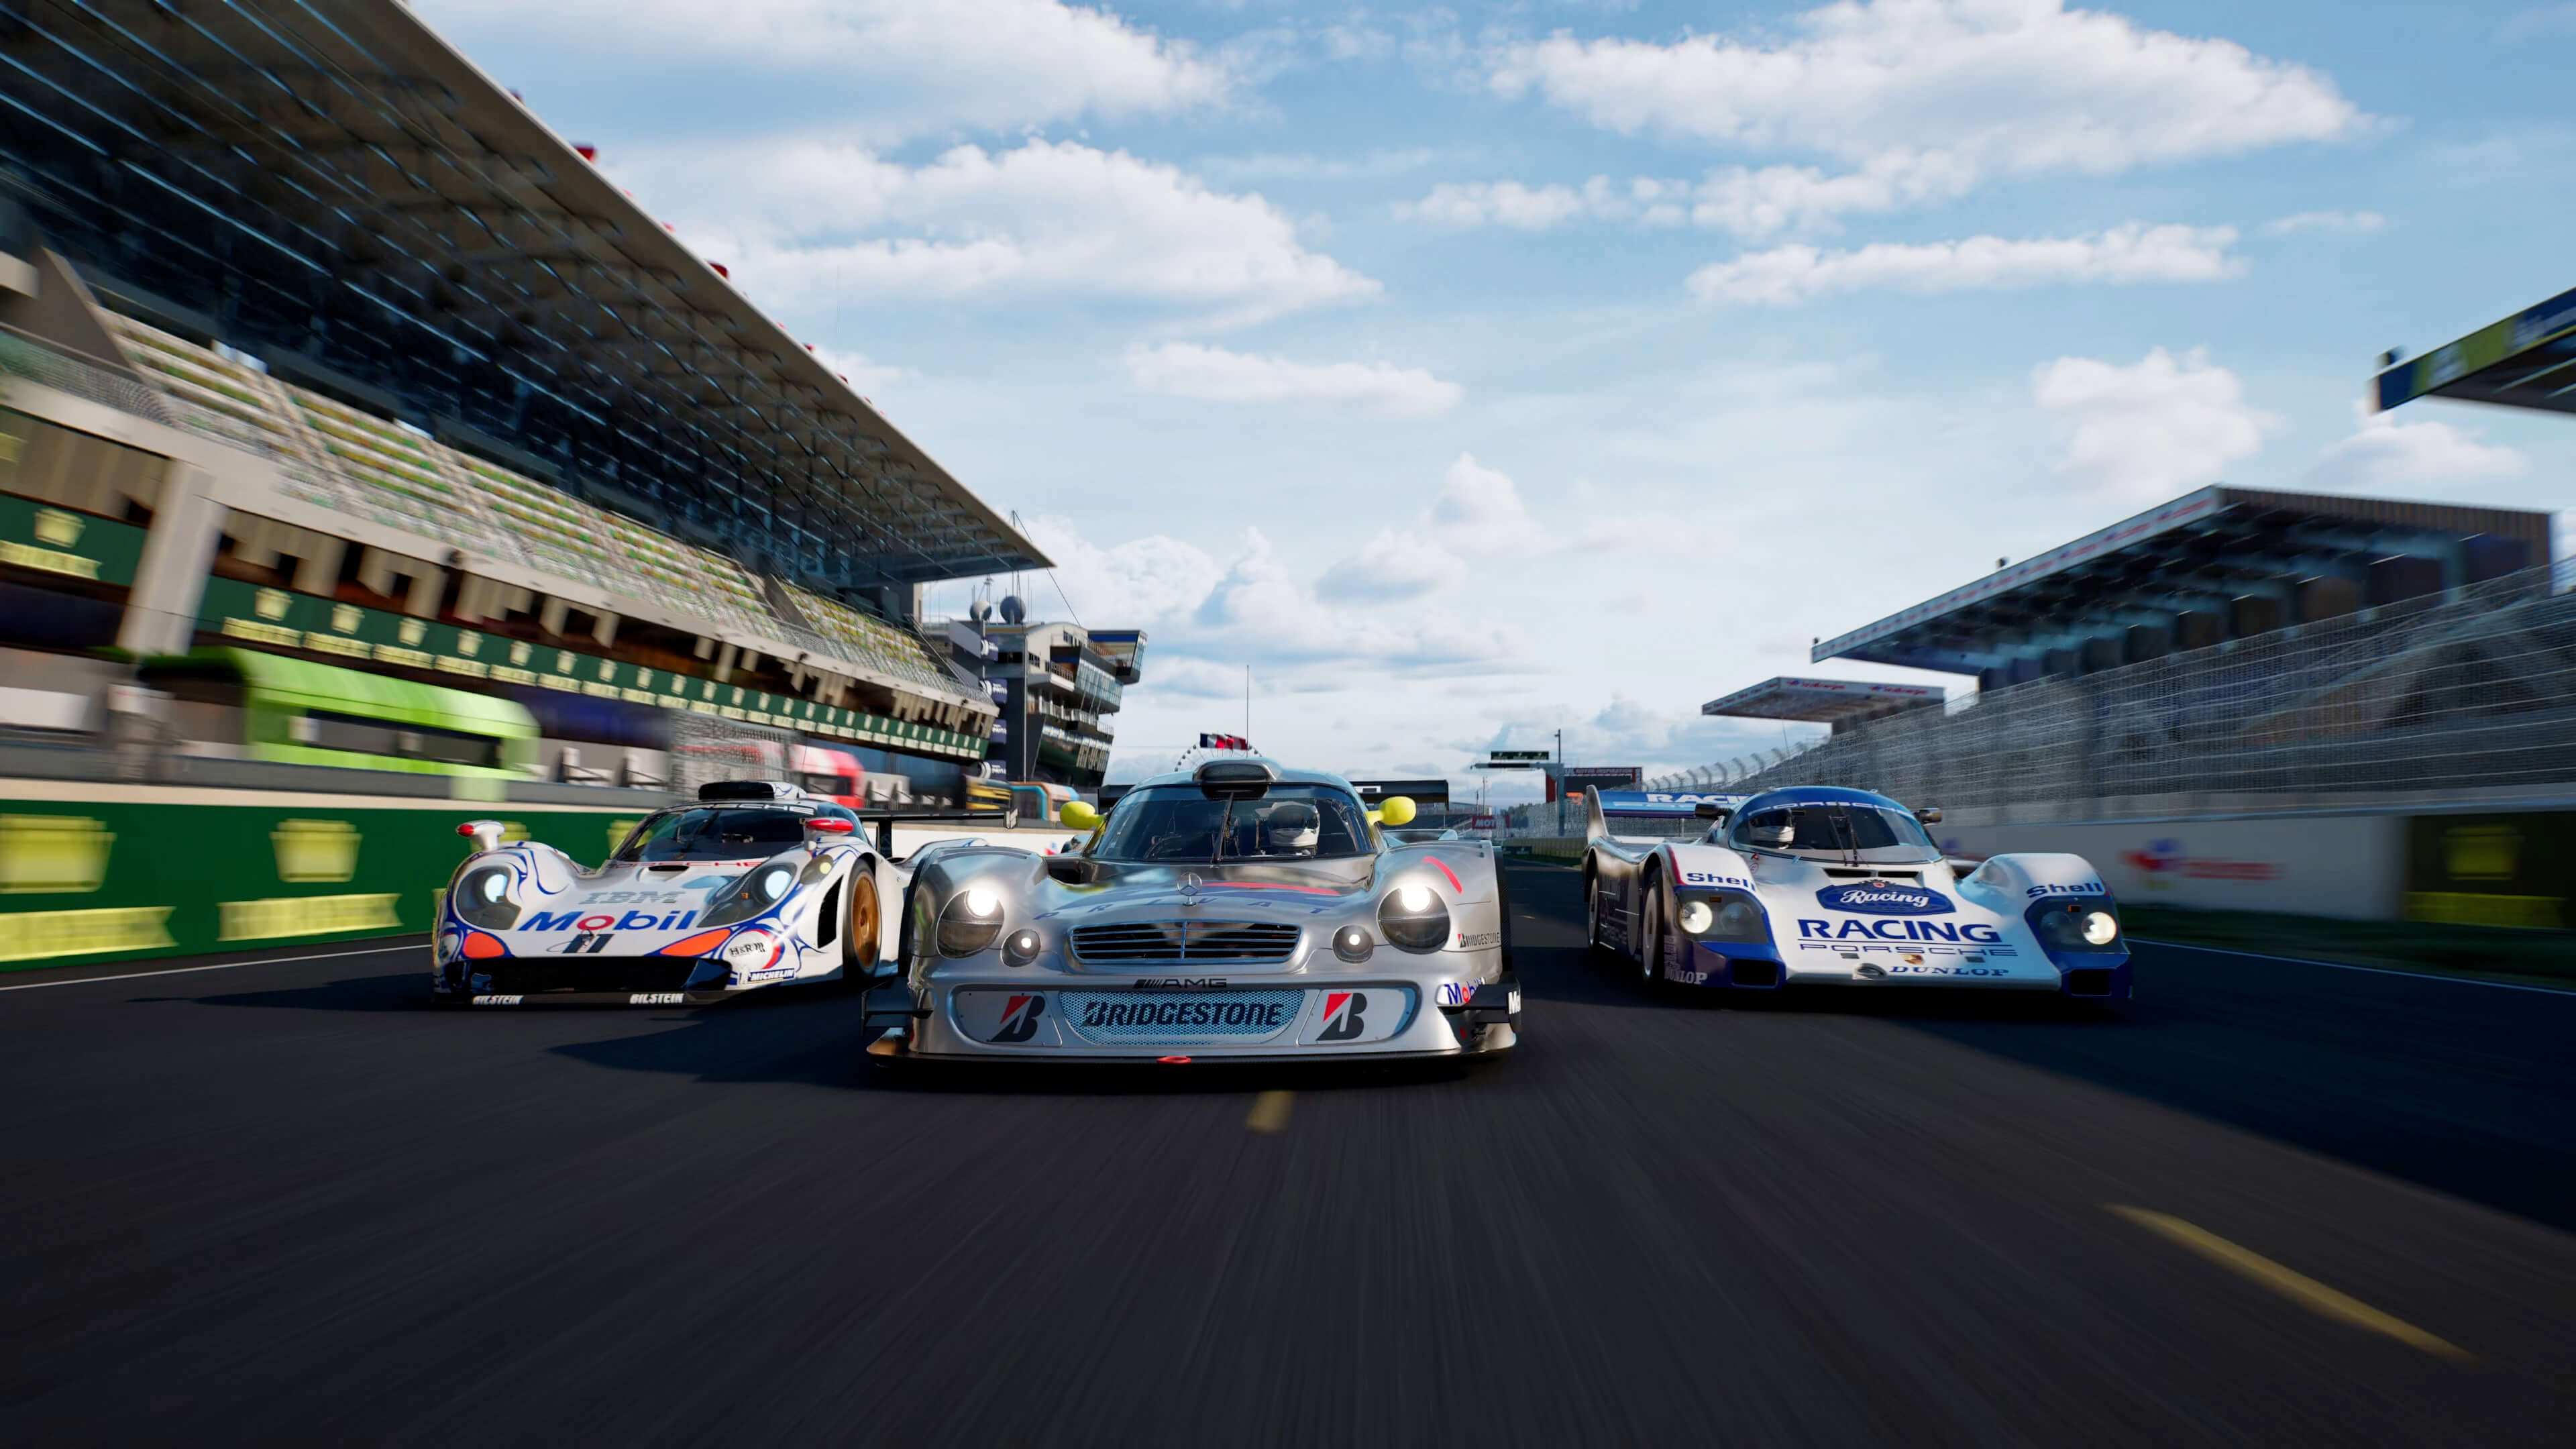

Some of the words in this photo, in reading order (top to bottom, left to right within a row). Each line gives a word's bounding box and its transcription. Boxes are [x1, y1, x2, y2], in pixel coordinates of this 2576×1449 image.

[1687, 873, 1756, 892] Shell
[579, 891, 686, 904] IBM
[2026, 883, 2104, 898] Shell
[1840, 890, 1929, 907] Racing
[517, 910, 699, 931] Mobil
[1797, 919, 2002, 943] RACING
[1458, 932, 1500, 948] BRIDGESTONE
[1800, 943, 2019, 957] PORSCHE
[751, 970, 794, 981] MICHELIN
[1889, 966, 2009, 977] DUNLOP
[1162, 978, 1227, 988] AMG
[1444, 977, 1481, 1005] Mob
[472, 995, 524, 1005] BILSTEIN
[630, 994, 684, 1004] BILSTEIN
[1083, 1002, 1282, 1027] BRIDGESTONE
